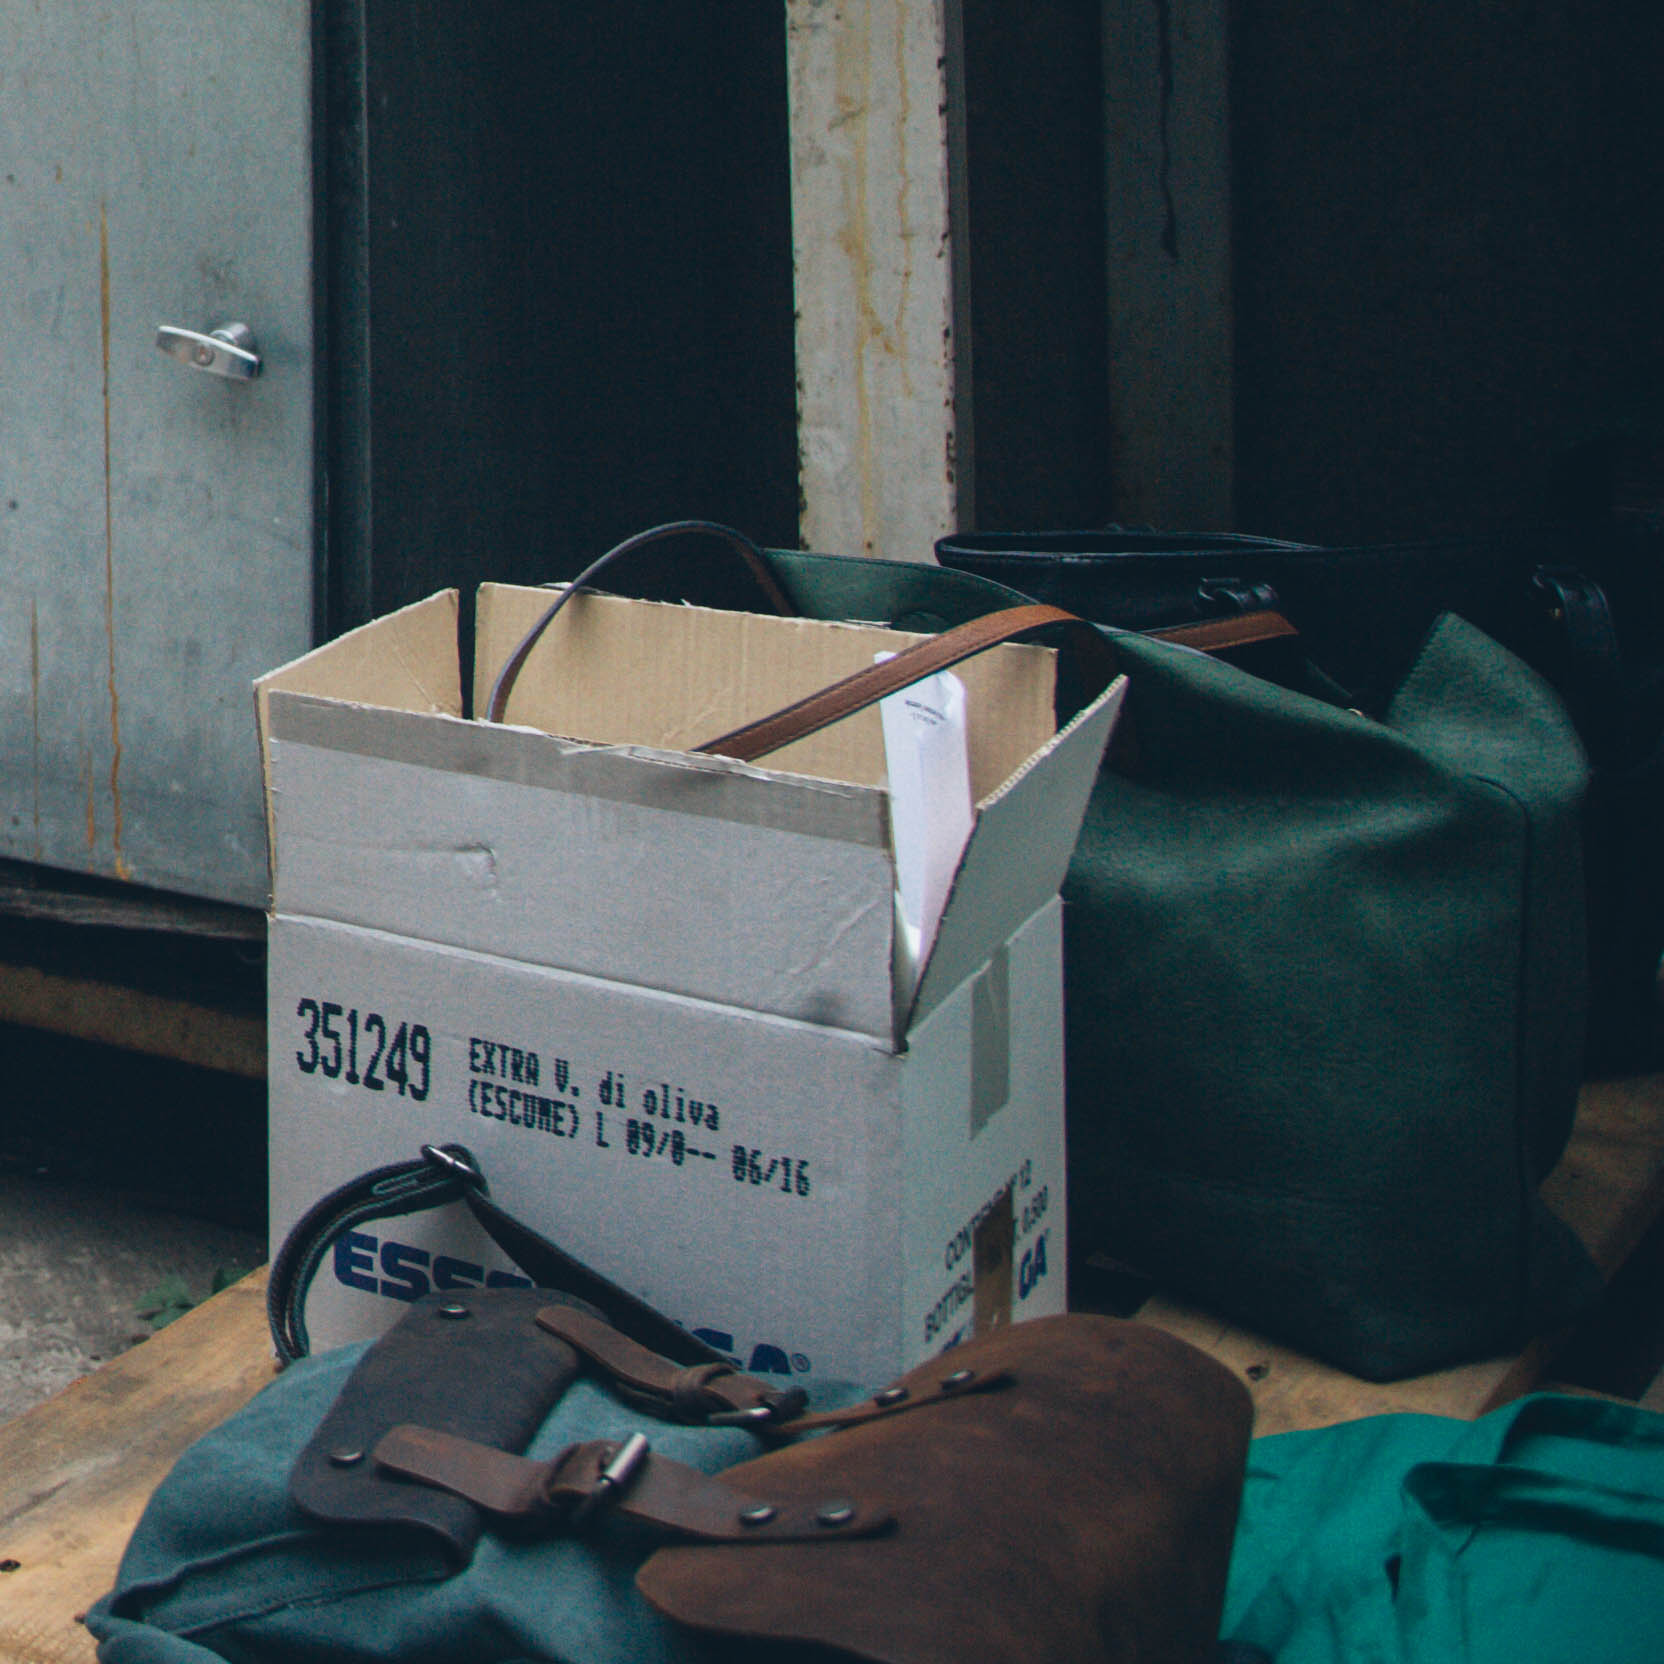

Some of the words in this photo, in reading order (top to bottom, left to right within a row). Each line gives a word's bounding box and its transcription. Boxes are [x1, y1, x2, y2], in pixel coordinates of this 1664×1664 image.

[296, 997, 431, 1101] 351249
[469, 1037, 540, 1086] EXTRA
[554, 1057, 579, 1096] V.
[598, 1070, 627, 1108] di
[642, 1083, 720, 1131] oliva
[731, 1144, 811, 1197] 06/16
